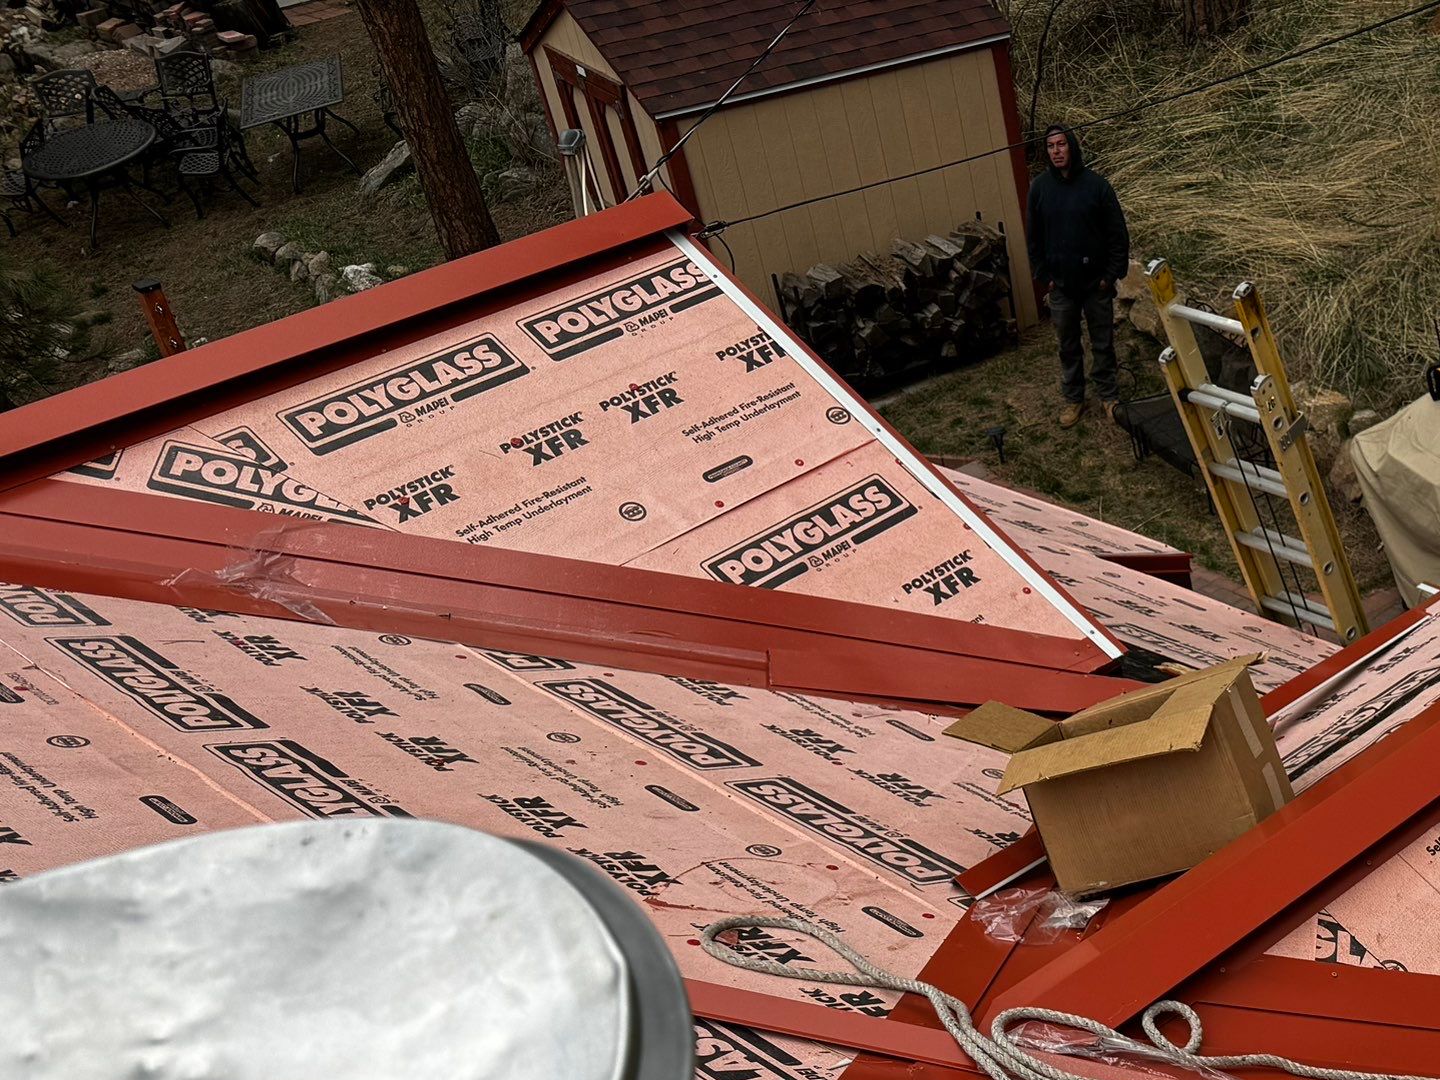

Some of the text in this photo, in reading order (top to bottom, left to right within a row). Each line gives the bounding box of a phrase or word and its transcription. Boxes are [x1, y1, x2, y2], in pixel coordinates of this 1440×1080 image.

[533, 262, 712, 344] POLYGLASS
[638, 308, 668, 326] MAPEI
[295, 342, 504, 438] POLYGLASS
[413, 396, 449, 418] MAPEI
[599, 372, 680, 412] POLYSTICK
[621, 386, 685, 424] XFR
[682, 382, 795, 437] Self-Adhered Fire-Resistant
[692, 391, 801, 444] High Temp Underlayment
[522, 427, 590, 467] XFR
[364, 466, 455, 510] POLYSTICK
[399, 481, 460, 524] XFR
[455, 476, 587, 537] Self-Adhered Fire-Resistant
[467, 485, 593, 545] High Temp Underlayment
[716, 484, 893, 585] POLYGLASS
[822, 541, 852, 561] MAPEI
[901, 550, 973, 595] POLYSTICK
[923, 567, 982, 607] XFR
[512, 795, 589, 830] XFR
[747, 783, 949, 880] POLYGLASS
